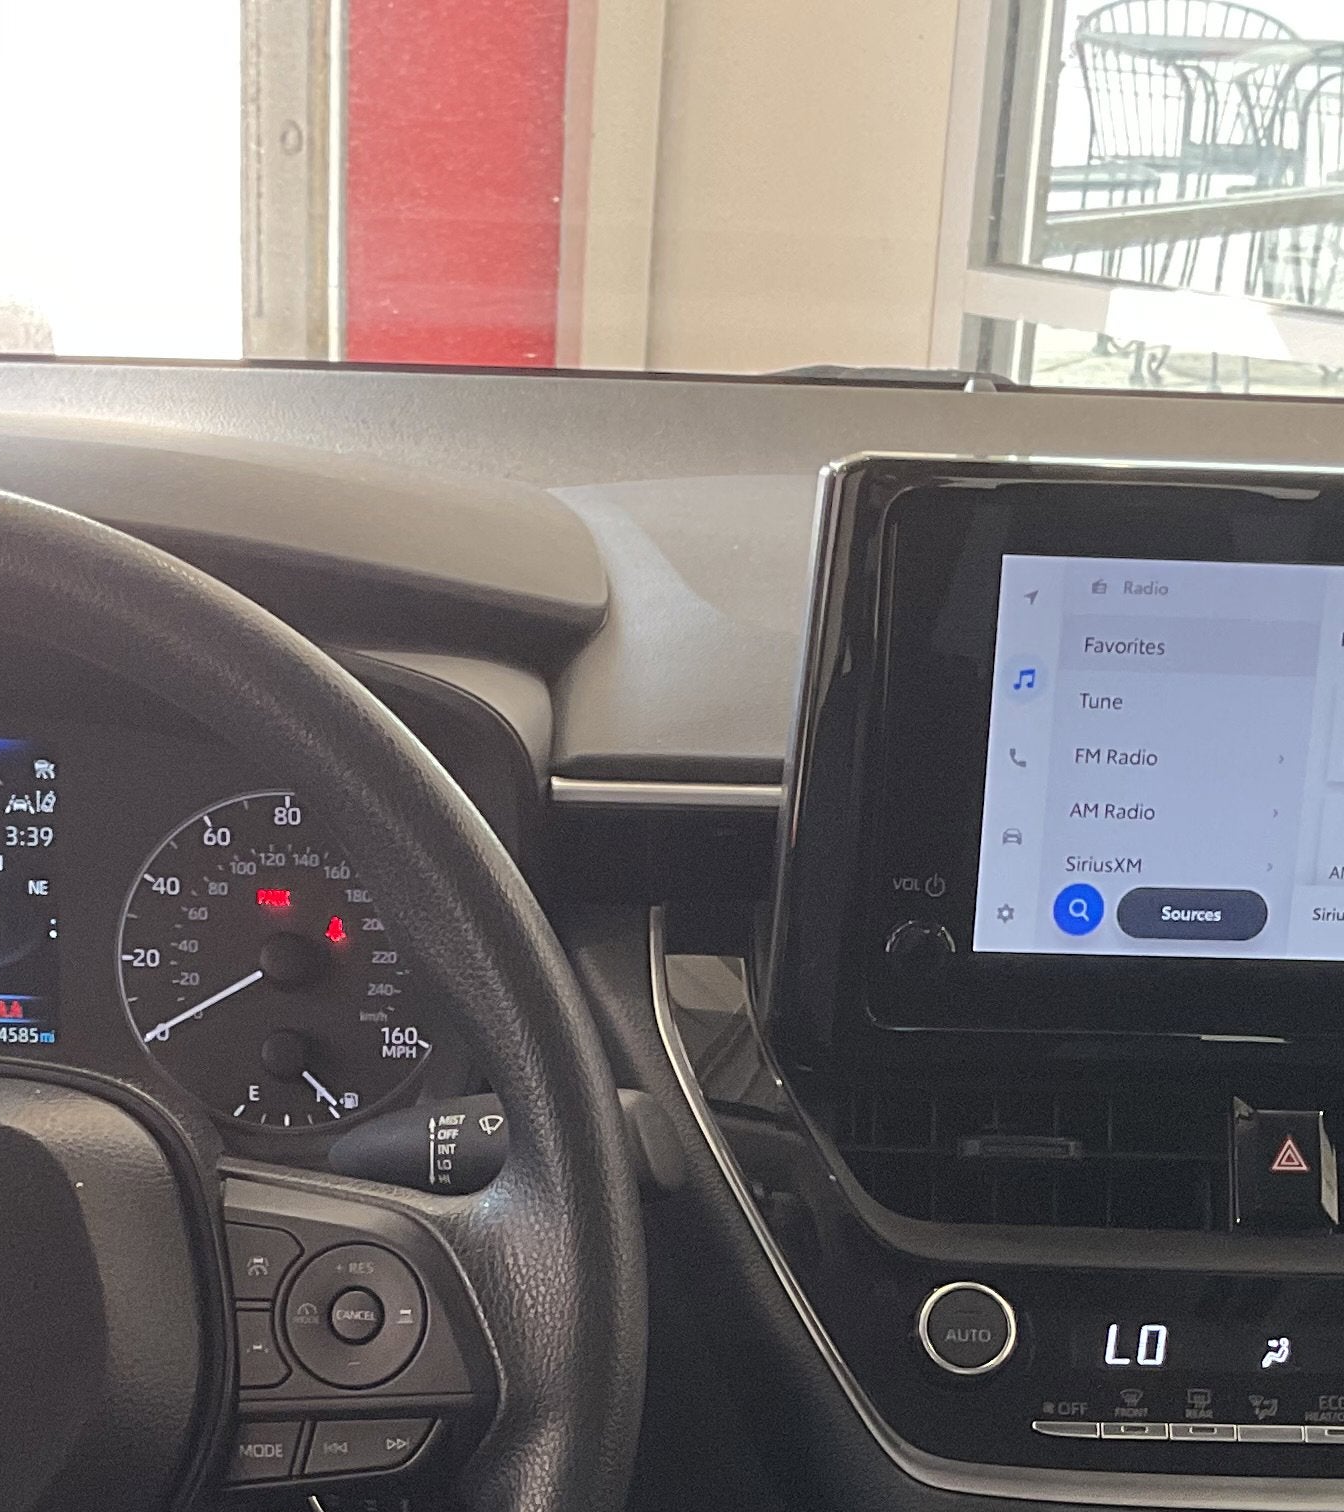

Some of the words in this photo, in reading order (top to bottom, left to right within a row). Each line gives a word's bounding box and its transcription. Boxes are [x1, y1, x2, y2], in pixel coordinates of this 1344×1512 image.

[1123, 581, 1169, 596] Radio
[1084, 637, 1166, 656] Favorites
[1080, 693, 1123, 710] Tune
[1075, 748, 1101, 764] FM
[1106, 749, 1158, 767] Radio
[273, 808, 301, 826] 80
[1070, 804, 1099, 819] AM
[1104, 804, 1156, 822] Radio
[5, 827, 54, 847] 3:39
[203, 827, 231, 847] 60
[259, 853, 286, 867] 120
[293, 853, 320, 868] 140
[1065, 857, 1143, 875] SiriusXM
[230, 861, 256, 876] 100
[324, 866, 351, 880] 160
[28, 879, 49, 896] NE
[152, 877, 180, 896] 40
[208, 882, 228, 896] 80
[892, 878, 921, 891] VOL
[188, 907, 208, 921] 60
[1161, 906, 1221, 923] Sources
[177, 940, 199, 953] 40
[132, 949, 160, 967] 20
[371, 951, 397, 964] 220
[179, 972, 200, 986] 20
[367, 983, 394, 996] 240
[380, 1027, 418, 1045] 160
[382, 1046, 416, 1059] MPH
[249, 1085, 260, 1101] E
[438, 1114, 466, 1126] MIST
[437, 1129, 459, 1140] OFF
[437, 1143, 456, 1155] INT
[437, 1159, 452, 1171] LO
[336, 1309, 376, 1321] CANCEL
[945, 1327, 992, 1344] AUTO
[1058, 1402, 1089, 1416] OFF
[239, 1444, 283, 1458] MODE
